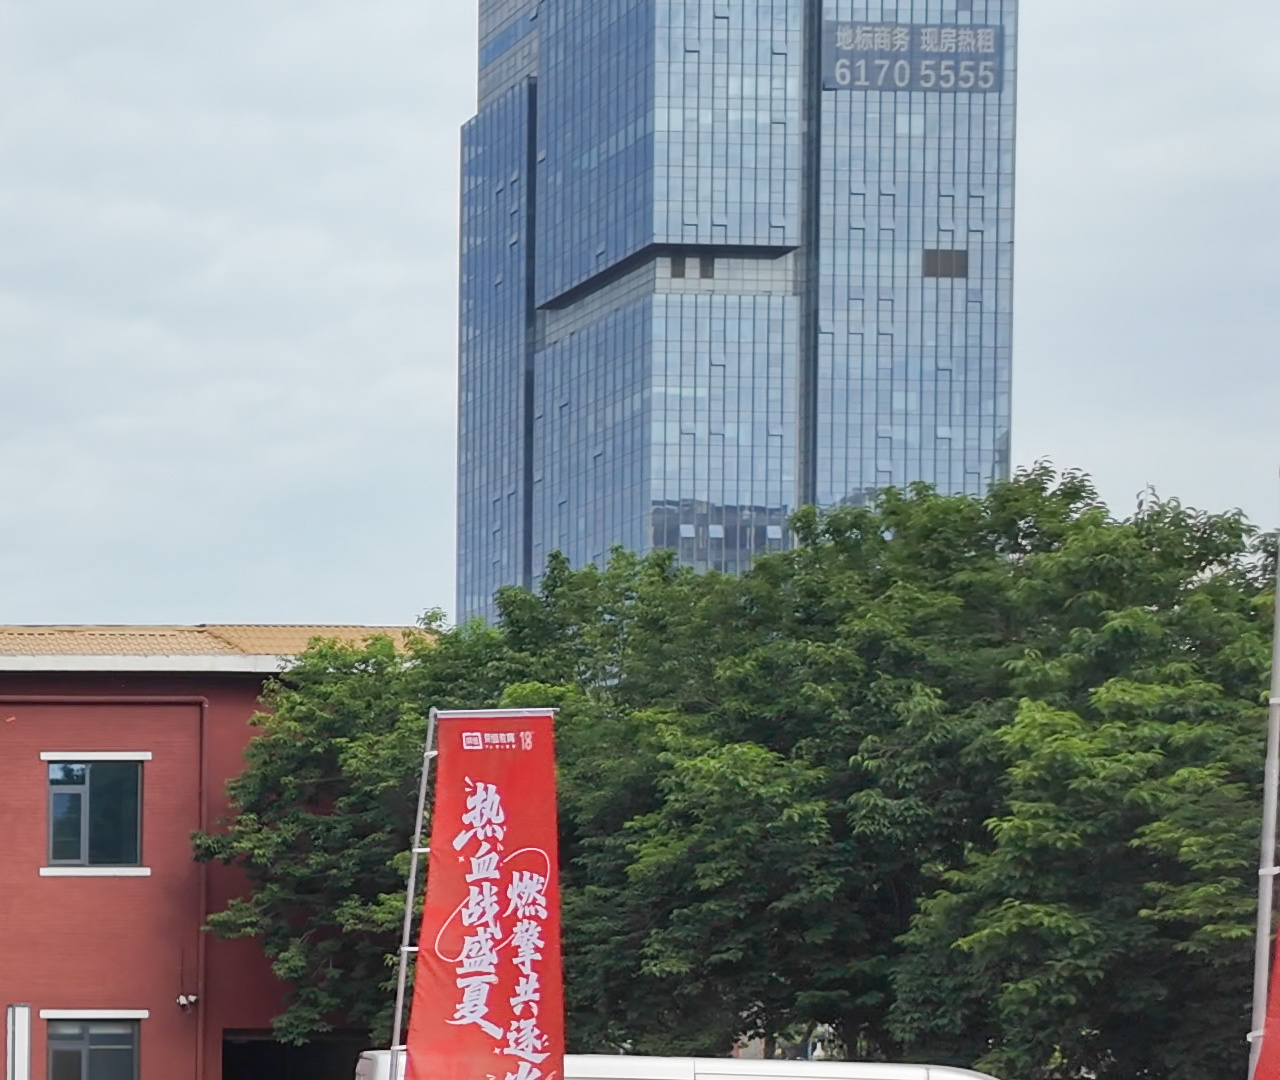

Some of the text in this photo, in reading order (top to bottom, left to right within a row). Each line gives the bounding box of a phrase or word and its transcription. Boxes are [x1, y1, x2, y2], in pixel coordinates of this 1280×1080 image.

[835, 25, 995, 53] 地标商务 现房热租
[835, 58, 995, 88] 6170 5555
[444, 782, 505, 1040] 热血战盛夏
